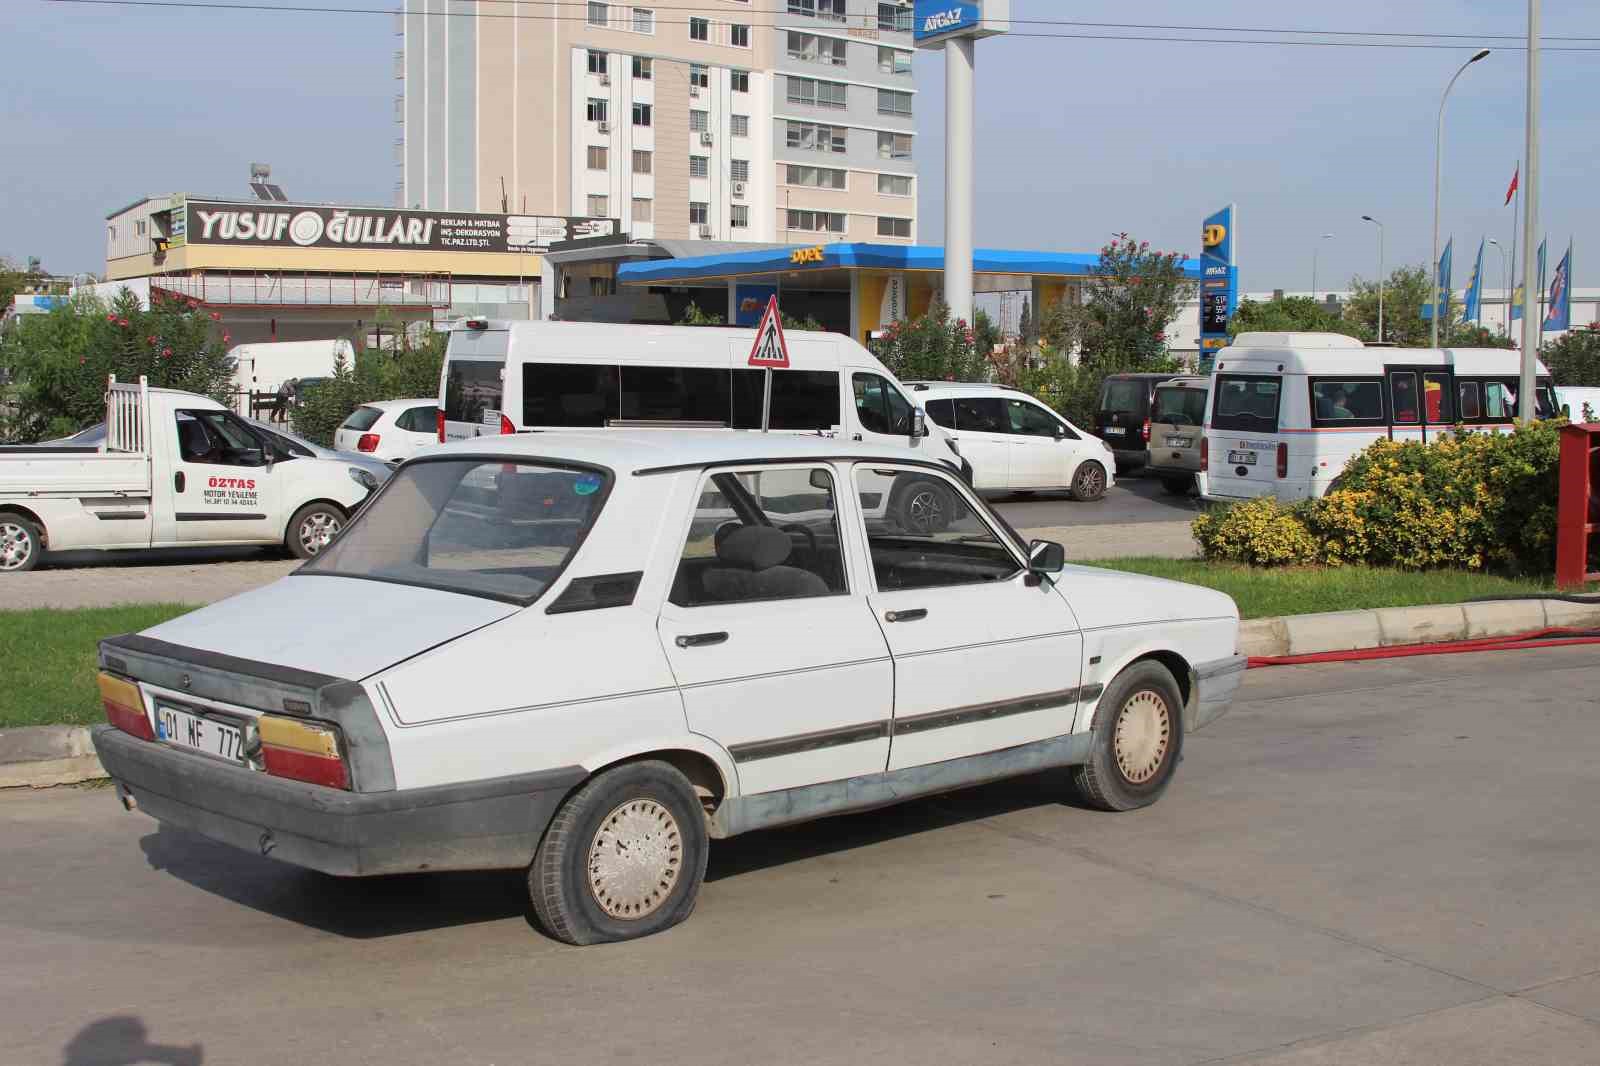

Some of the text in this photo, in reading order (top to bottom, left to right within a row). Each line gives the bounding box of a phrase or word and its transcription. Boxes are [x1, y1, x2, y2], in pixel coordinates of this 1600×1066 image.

[924, 8, 962, 31] AYGAZ
[440, 218, 467, 227] REKLAM
[474, 220, 500, 228] MATBAA
[203, 490, 226, 498] MOTOR
[165, 711, 245, 761] 01 NF 772
